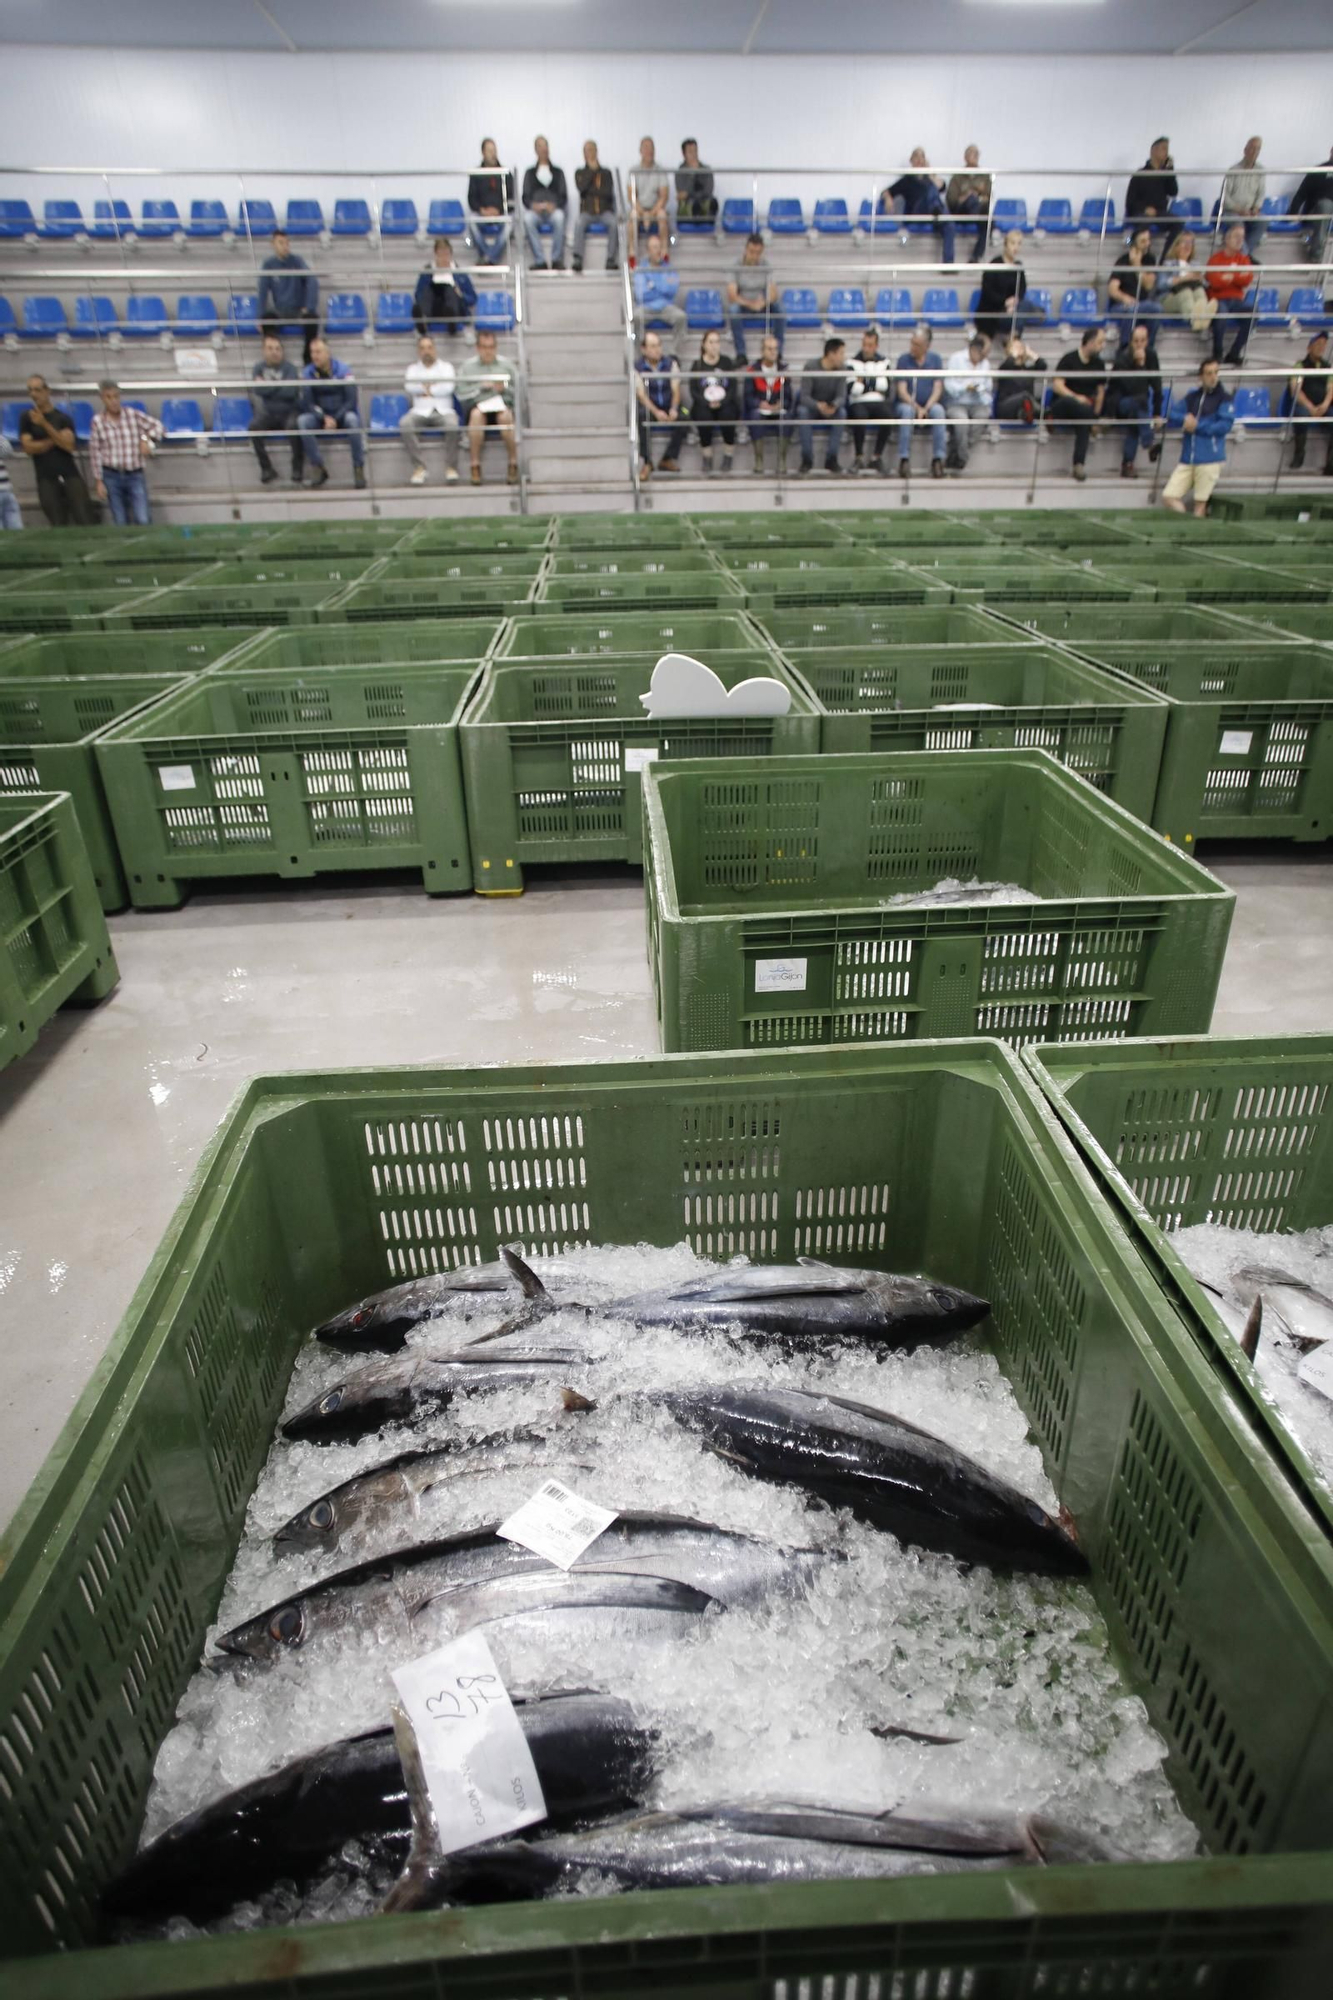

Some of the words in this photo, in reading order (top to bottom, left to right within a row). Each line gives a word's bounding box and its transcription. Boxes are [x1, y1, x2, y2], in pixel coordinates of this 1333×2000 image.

[426, 1690, 467, 1720] 13
[456, 1674, 503, 1714] 78
[467, 1788, 486, 1826] CAJON
[511, 1776, 527, 1812] KILOS
